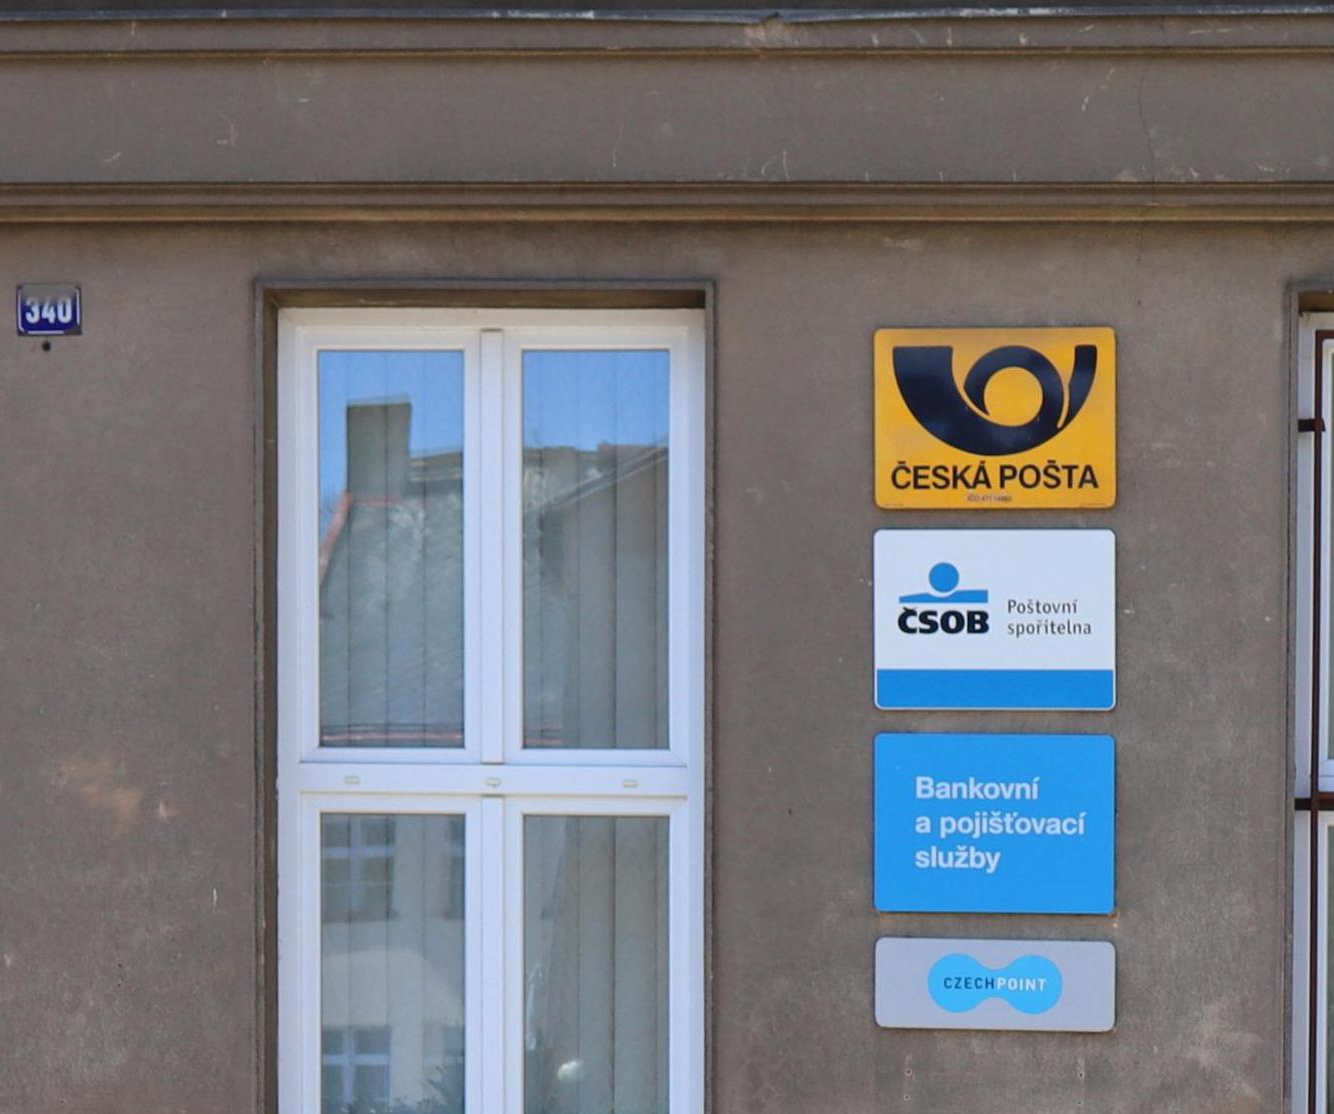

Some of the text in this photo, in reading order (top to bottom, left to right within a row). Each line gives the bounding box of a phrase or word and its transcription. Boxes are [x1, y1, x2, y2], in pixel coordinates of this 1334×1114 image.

[25, 297, 72, 324] 340
[891, 460, 1099, 489] ČESKÁ POŠTA
[897, 606, 990, 635] ČSOB
[1007, 599, 1078, 615] Poštovní
[1007, 619, 1092, 639] spořitelna
[915, 776, 1041, 800] Bankovní
[915, 811, 1087, 839] a pojišťovací
[915, 845, 1002, 874] služby
